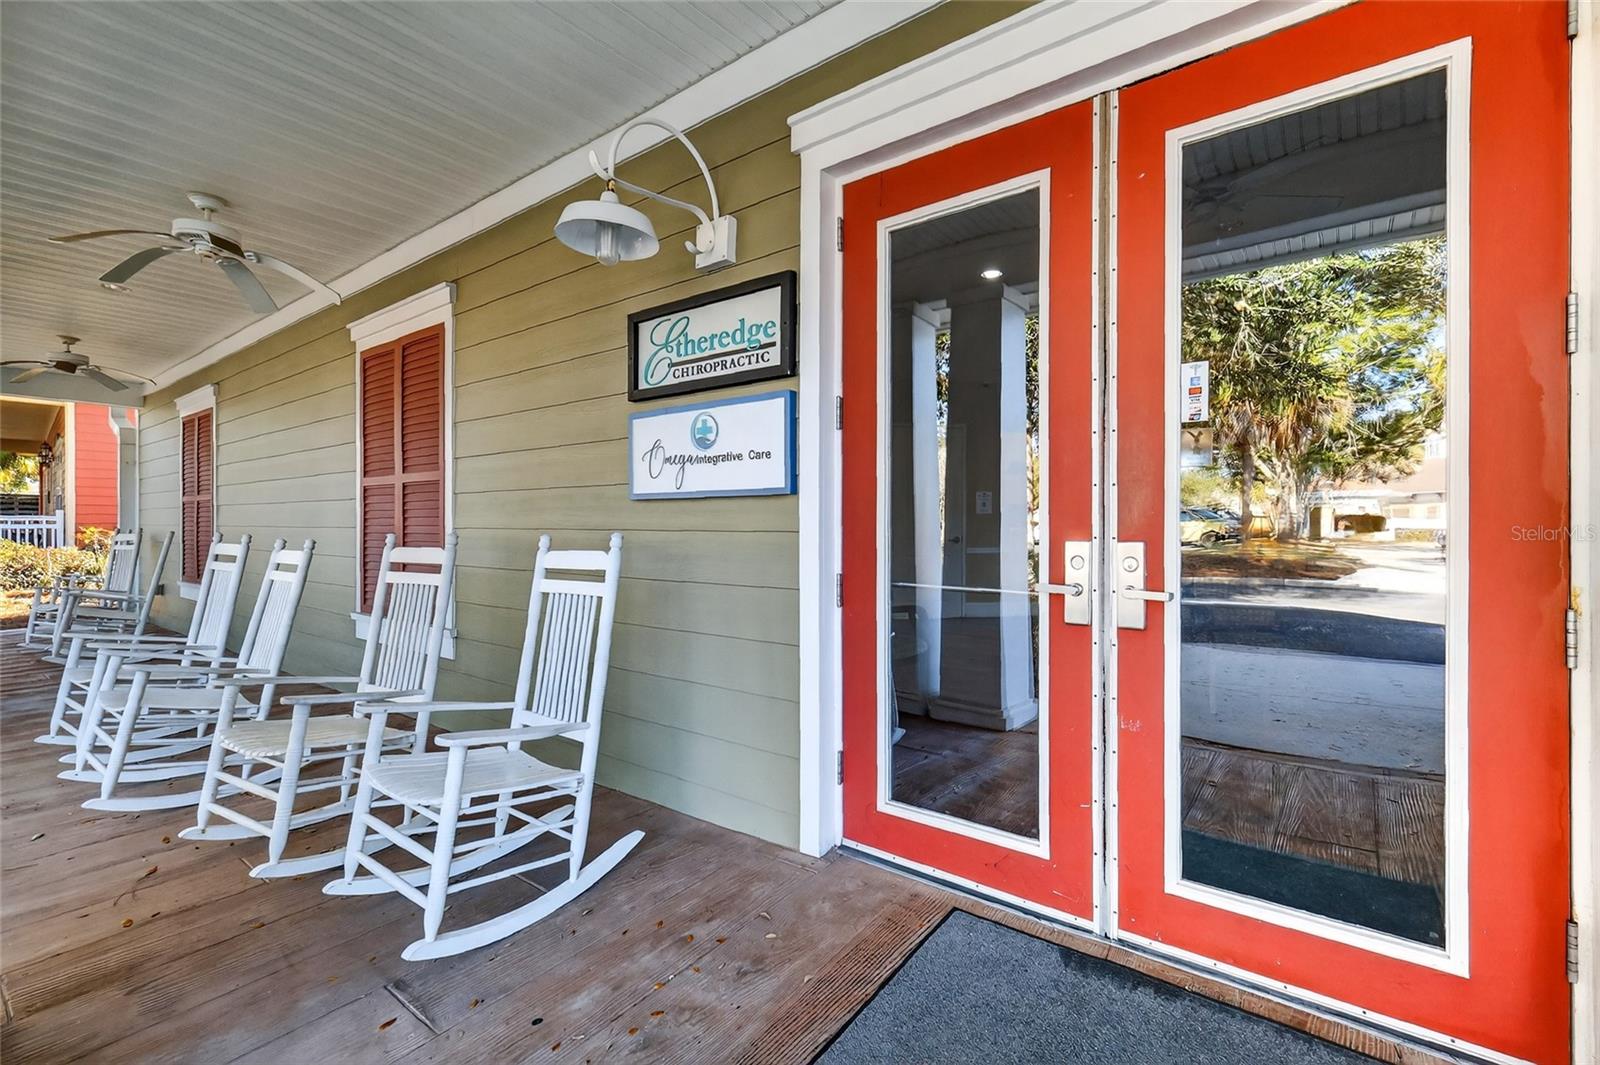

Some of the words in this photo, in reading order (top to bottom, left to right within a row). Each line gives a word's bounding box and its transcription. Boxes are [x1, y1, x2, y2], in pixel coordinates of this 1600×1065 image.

[644, 316, 777, 386] Etheredge
[672, 351, 770, 379] CHIROPRACTIC
[642, 439, 697, 490] Omega
[696, 451, 743, 465] Integrative
[748, 449, 772, 460] Care
